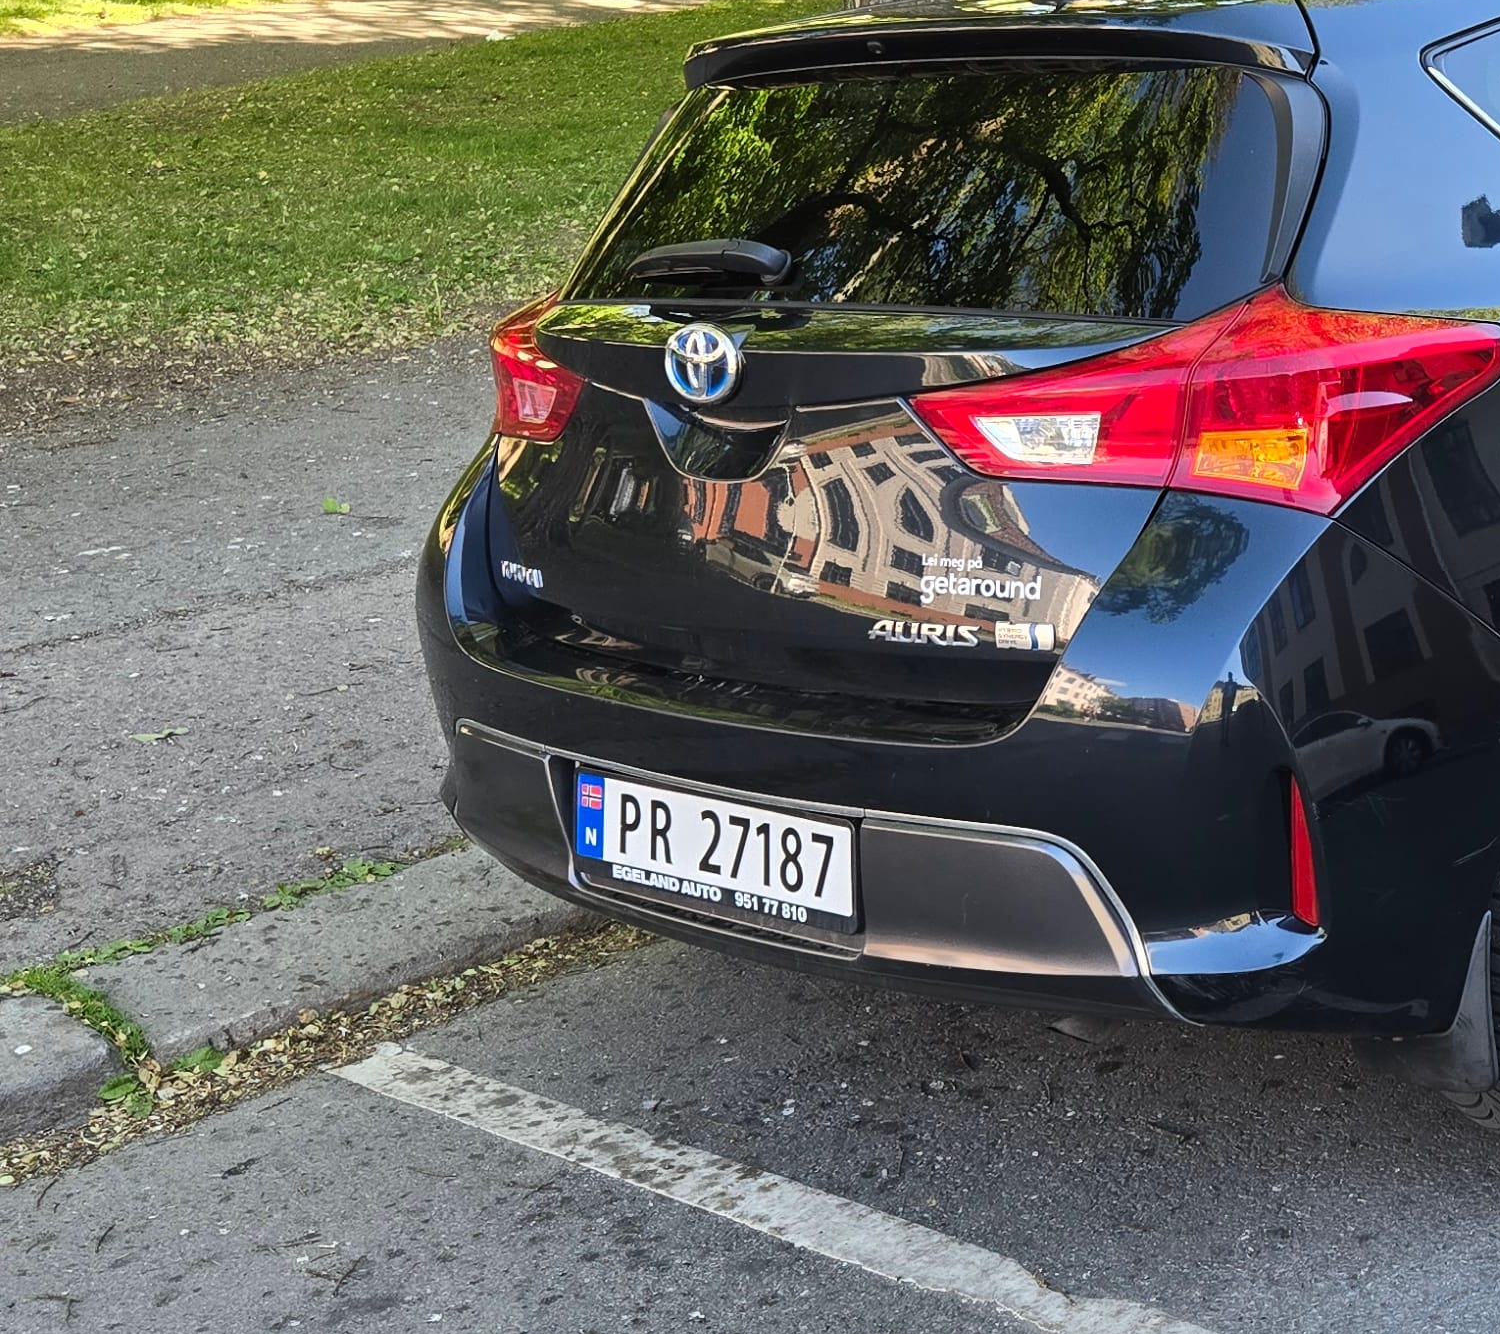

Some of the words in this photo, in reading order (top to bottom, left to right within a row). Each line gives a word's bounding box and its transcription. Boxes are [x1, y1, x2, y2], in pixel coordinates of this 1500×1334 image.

[921, 553, 938, 567] Lei
[940, 556, 965, 572] meg
[966, 555, 983, 573] på
[920, 572, 1042, 604] getaround
[868, 619, 980, 647] AURIS
[585, 827, 597, 847] N
[619, 793, 673, 865] PR
[698, 809, 834, 898] 27187
[612, 864, 681, 893] EGELAND
[680, 879, 722, 902] AUTO
[734, 892, 759, 911] 951
[762, 898, 779, 916] 77
[782, 904, 808, 924] 810
